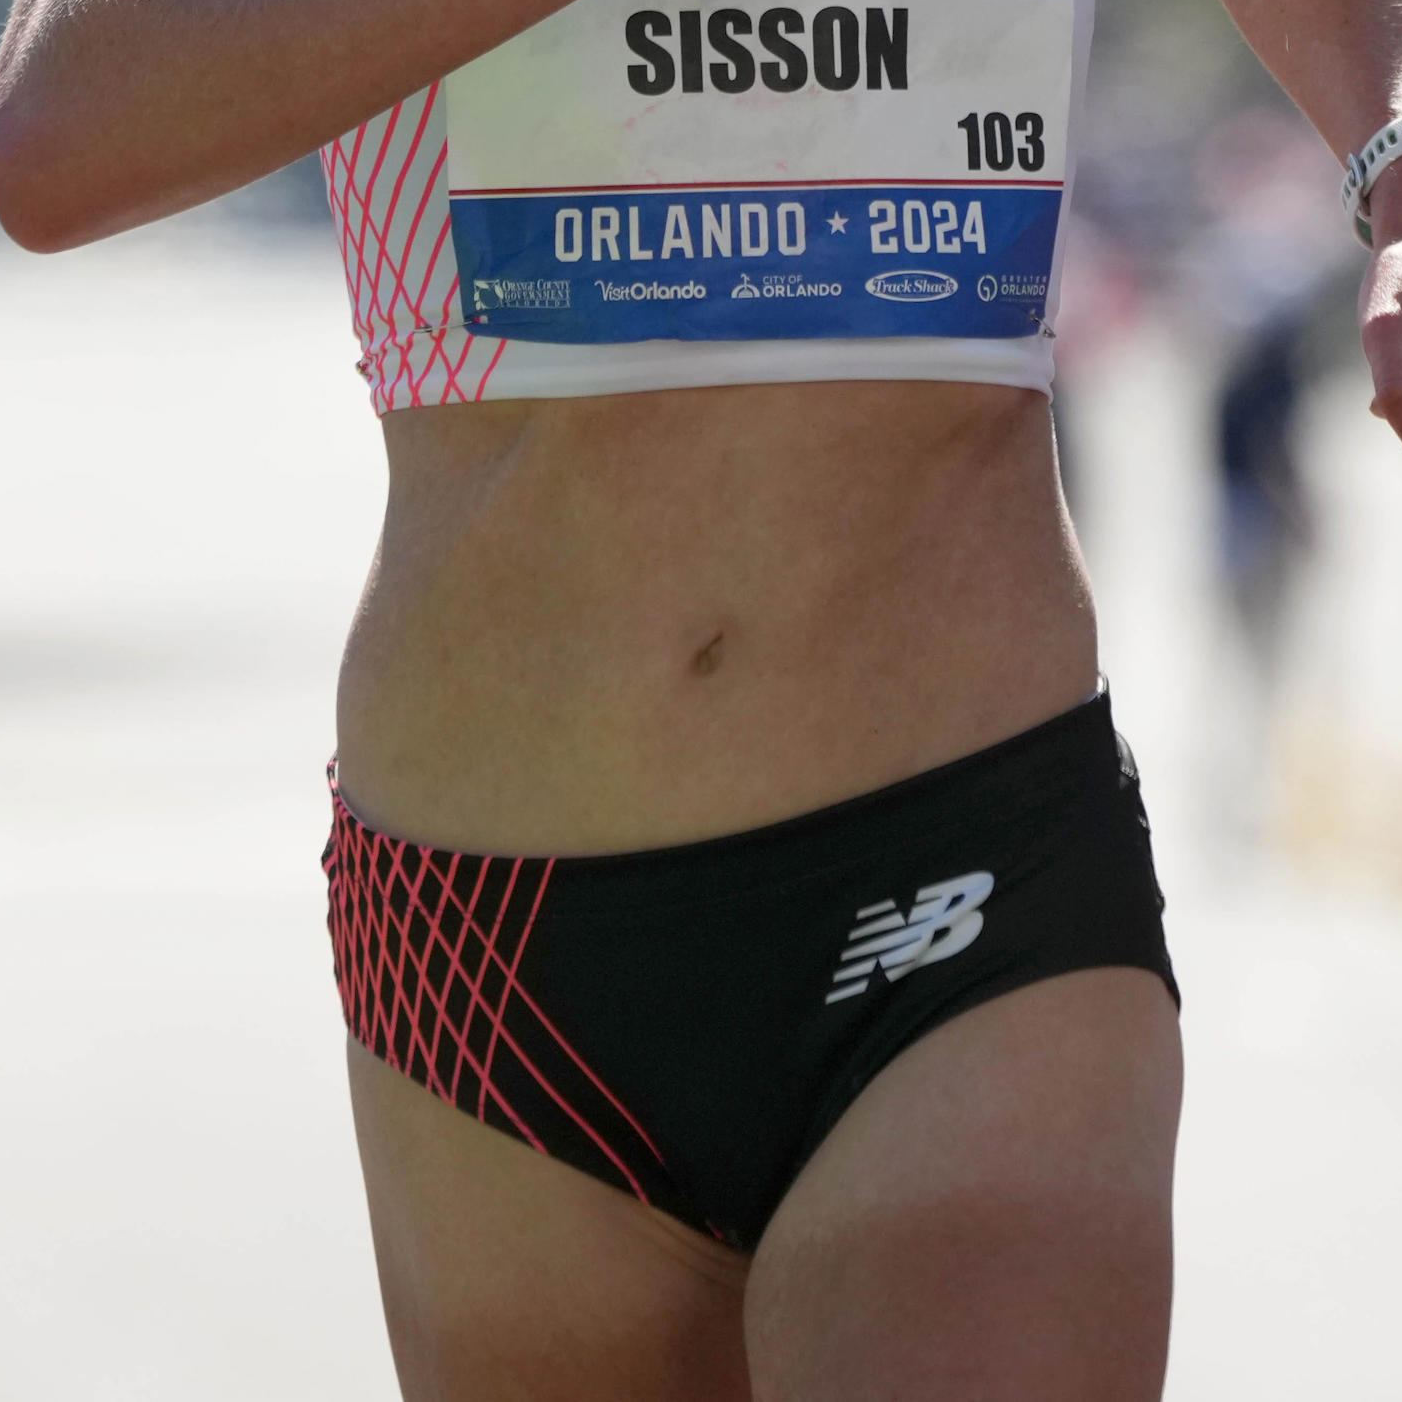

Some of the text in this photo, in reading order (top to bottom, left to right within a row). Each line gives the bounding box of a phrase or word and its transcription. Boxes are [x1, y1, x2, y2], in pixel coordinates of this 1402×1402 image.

[624, 5, 909, 96] SISSON
[957, 111, 1046, 172] 103
[554, 199, 987, 263] ORLANDO 2024
[762, 274, 804, 285] CITY OF
[762, 283, 842, 298] ORLANDO
[872, 278, 955, 295] Track Shack
[1001, 284, 1046, 296] ORLANDO
[824, 870, 995, 1005] NB
